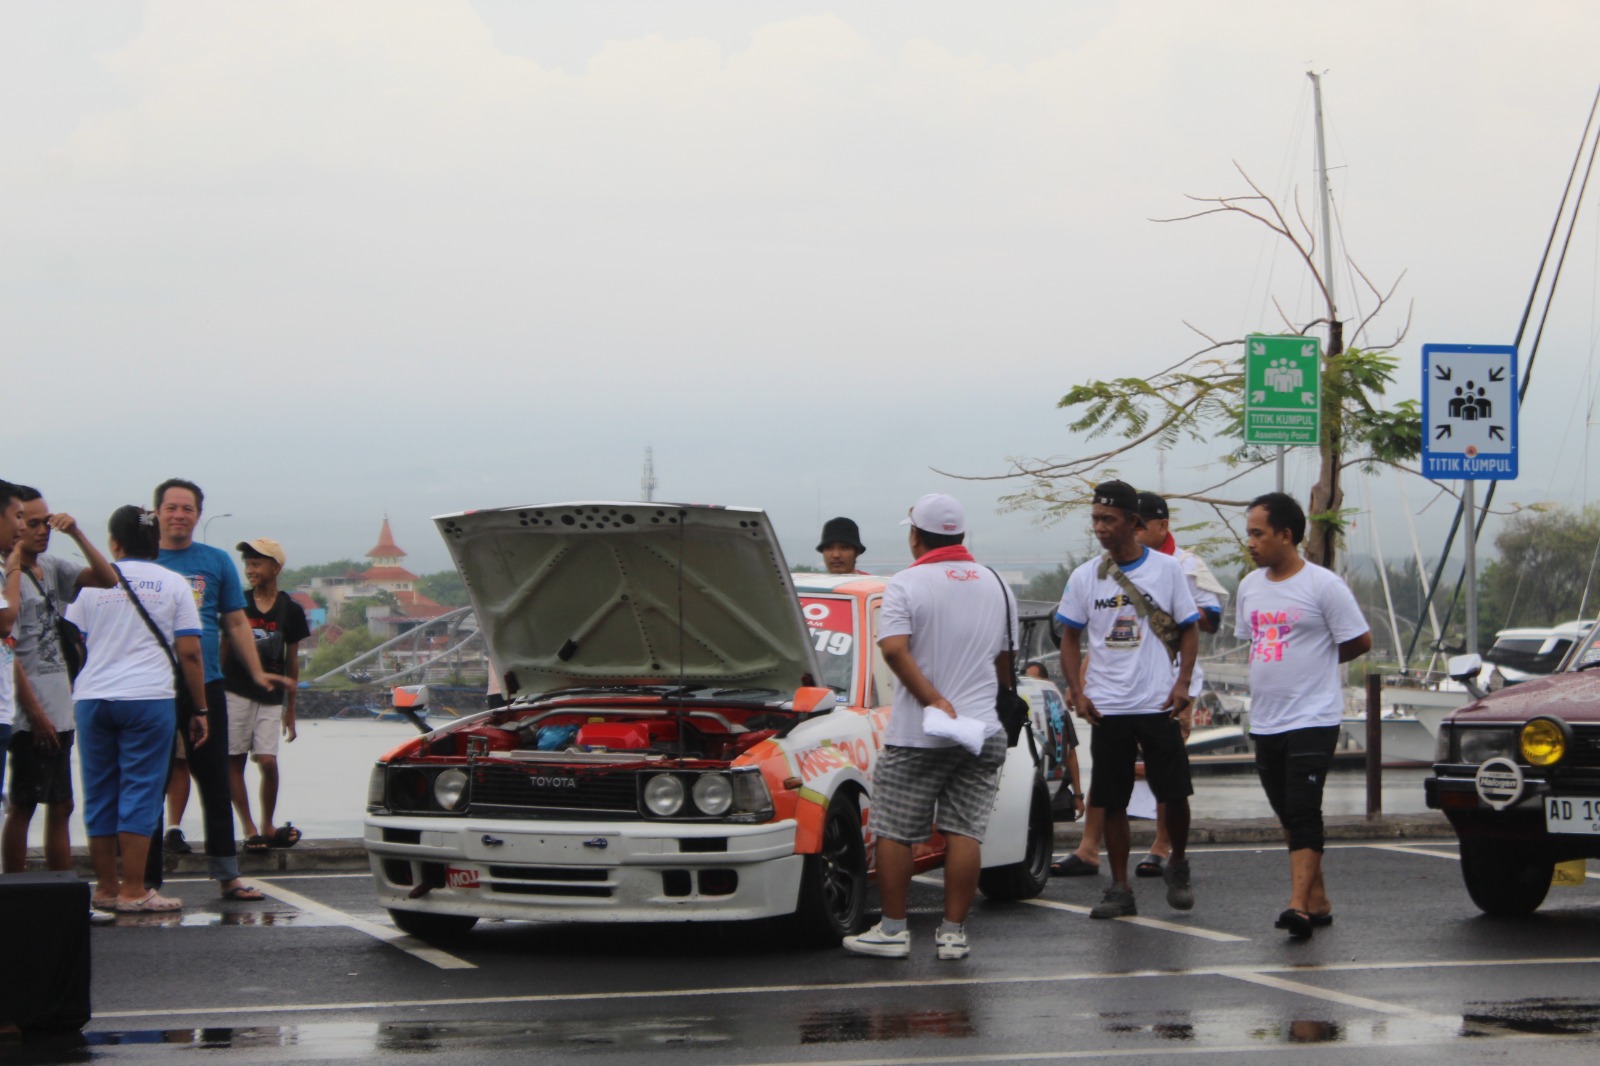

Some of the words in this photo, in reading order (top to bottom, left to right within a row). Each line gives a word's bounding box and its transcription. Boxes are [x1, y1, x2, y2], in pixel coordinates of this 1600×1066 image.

[1251, 414, 1274, 424] TITIK
[1276, 414, 1315, 425] KUMPUL
[1254, 430, 1289, 441] Assembly
[1290, 431, 1310, 440] Point
[1428, 458, 1460, 471] TITIK
[1463, 458, 1513, 472] KUMPUL
[809, 628, 853, 656] 19
[529, 776, 576, 788] TOYOTA
[1480, 777, 1517, 789] Halogen
[1550, 800, 1572, 820] AD
